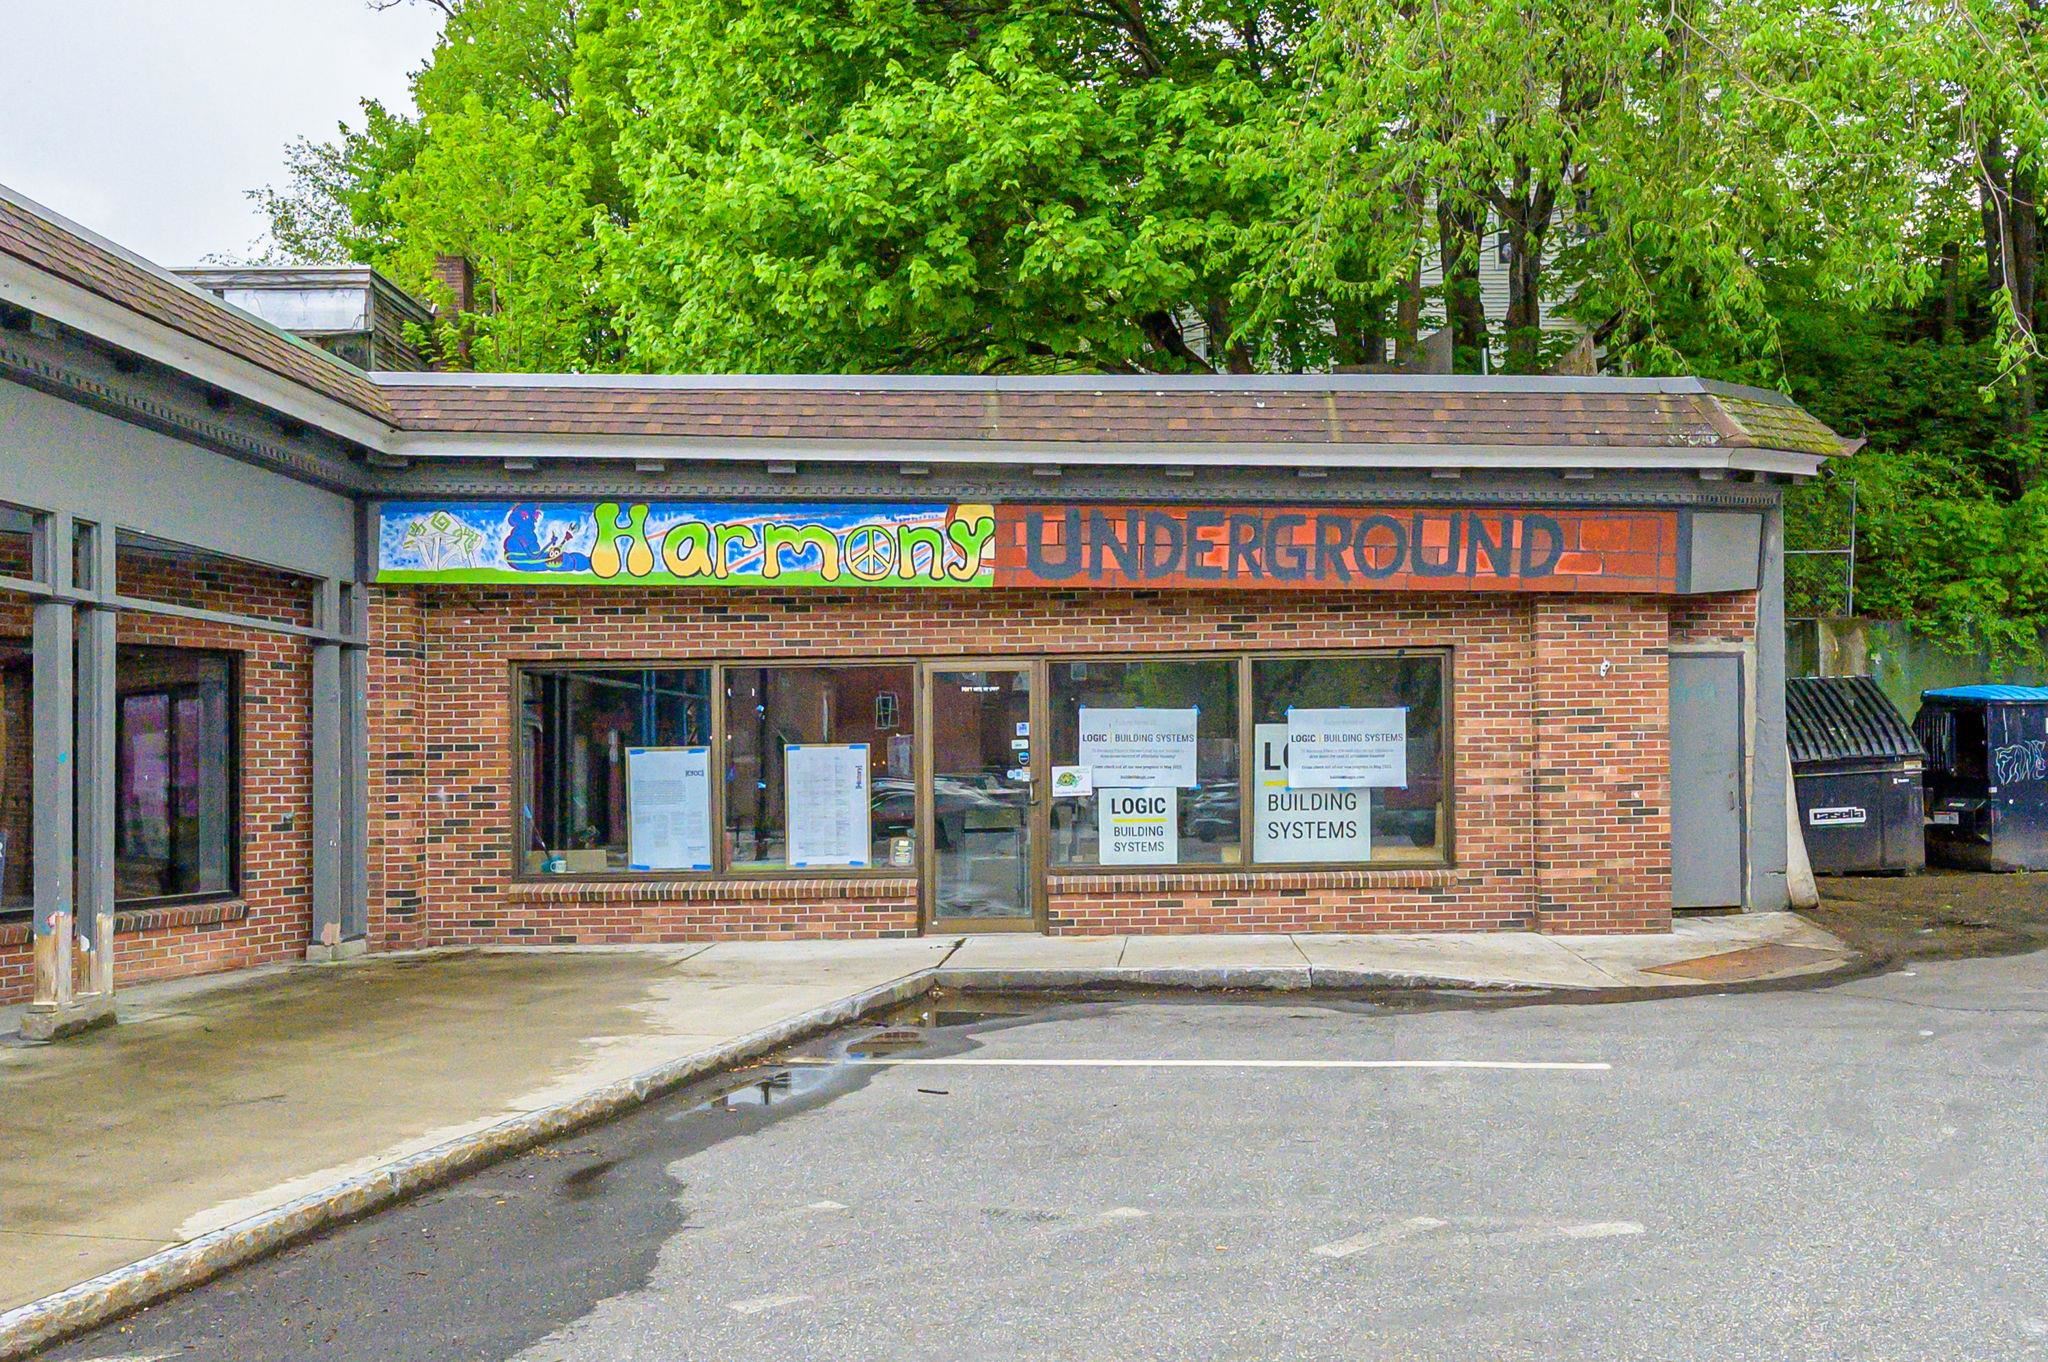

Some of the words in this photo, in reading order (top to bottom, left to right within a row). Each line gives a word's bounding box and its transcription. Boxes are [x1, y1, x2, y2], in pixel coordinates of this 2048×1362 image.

[589, 502, 997, 582] Harmony
[1025, 507, 1564, 582] UNDERGROUND
[1082, 733, 1108, 742] LOGIC
[1115, 733, 1154, 743] BUILDING
[1155, 733, 1195, 743] SYSTEMS
[1291, 734, 1316, 743] LOGIC
[1323, 734, 1363, 743] BUILDING
[1364, 733, 1404, 742] SYSTEMS
[1111, 797, 1166, 815] LOGIC
[1267, 792, 1357, 811] BUILDING
[1113, 825, 1164, 837] BUILDING
[1267, 820, 1357, 839] SYSTEMS
[1113, 841, 1165, 852] SYSTEMS
